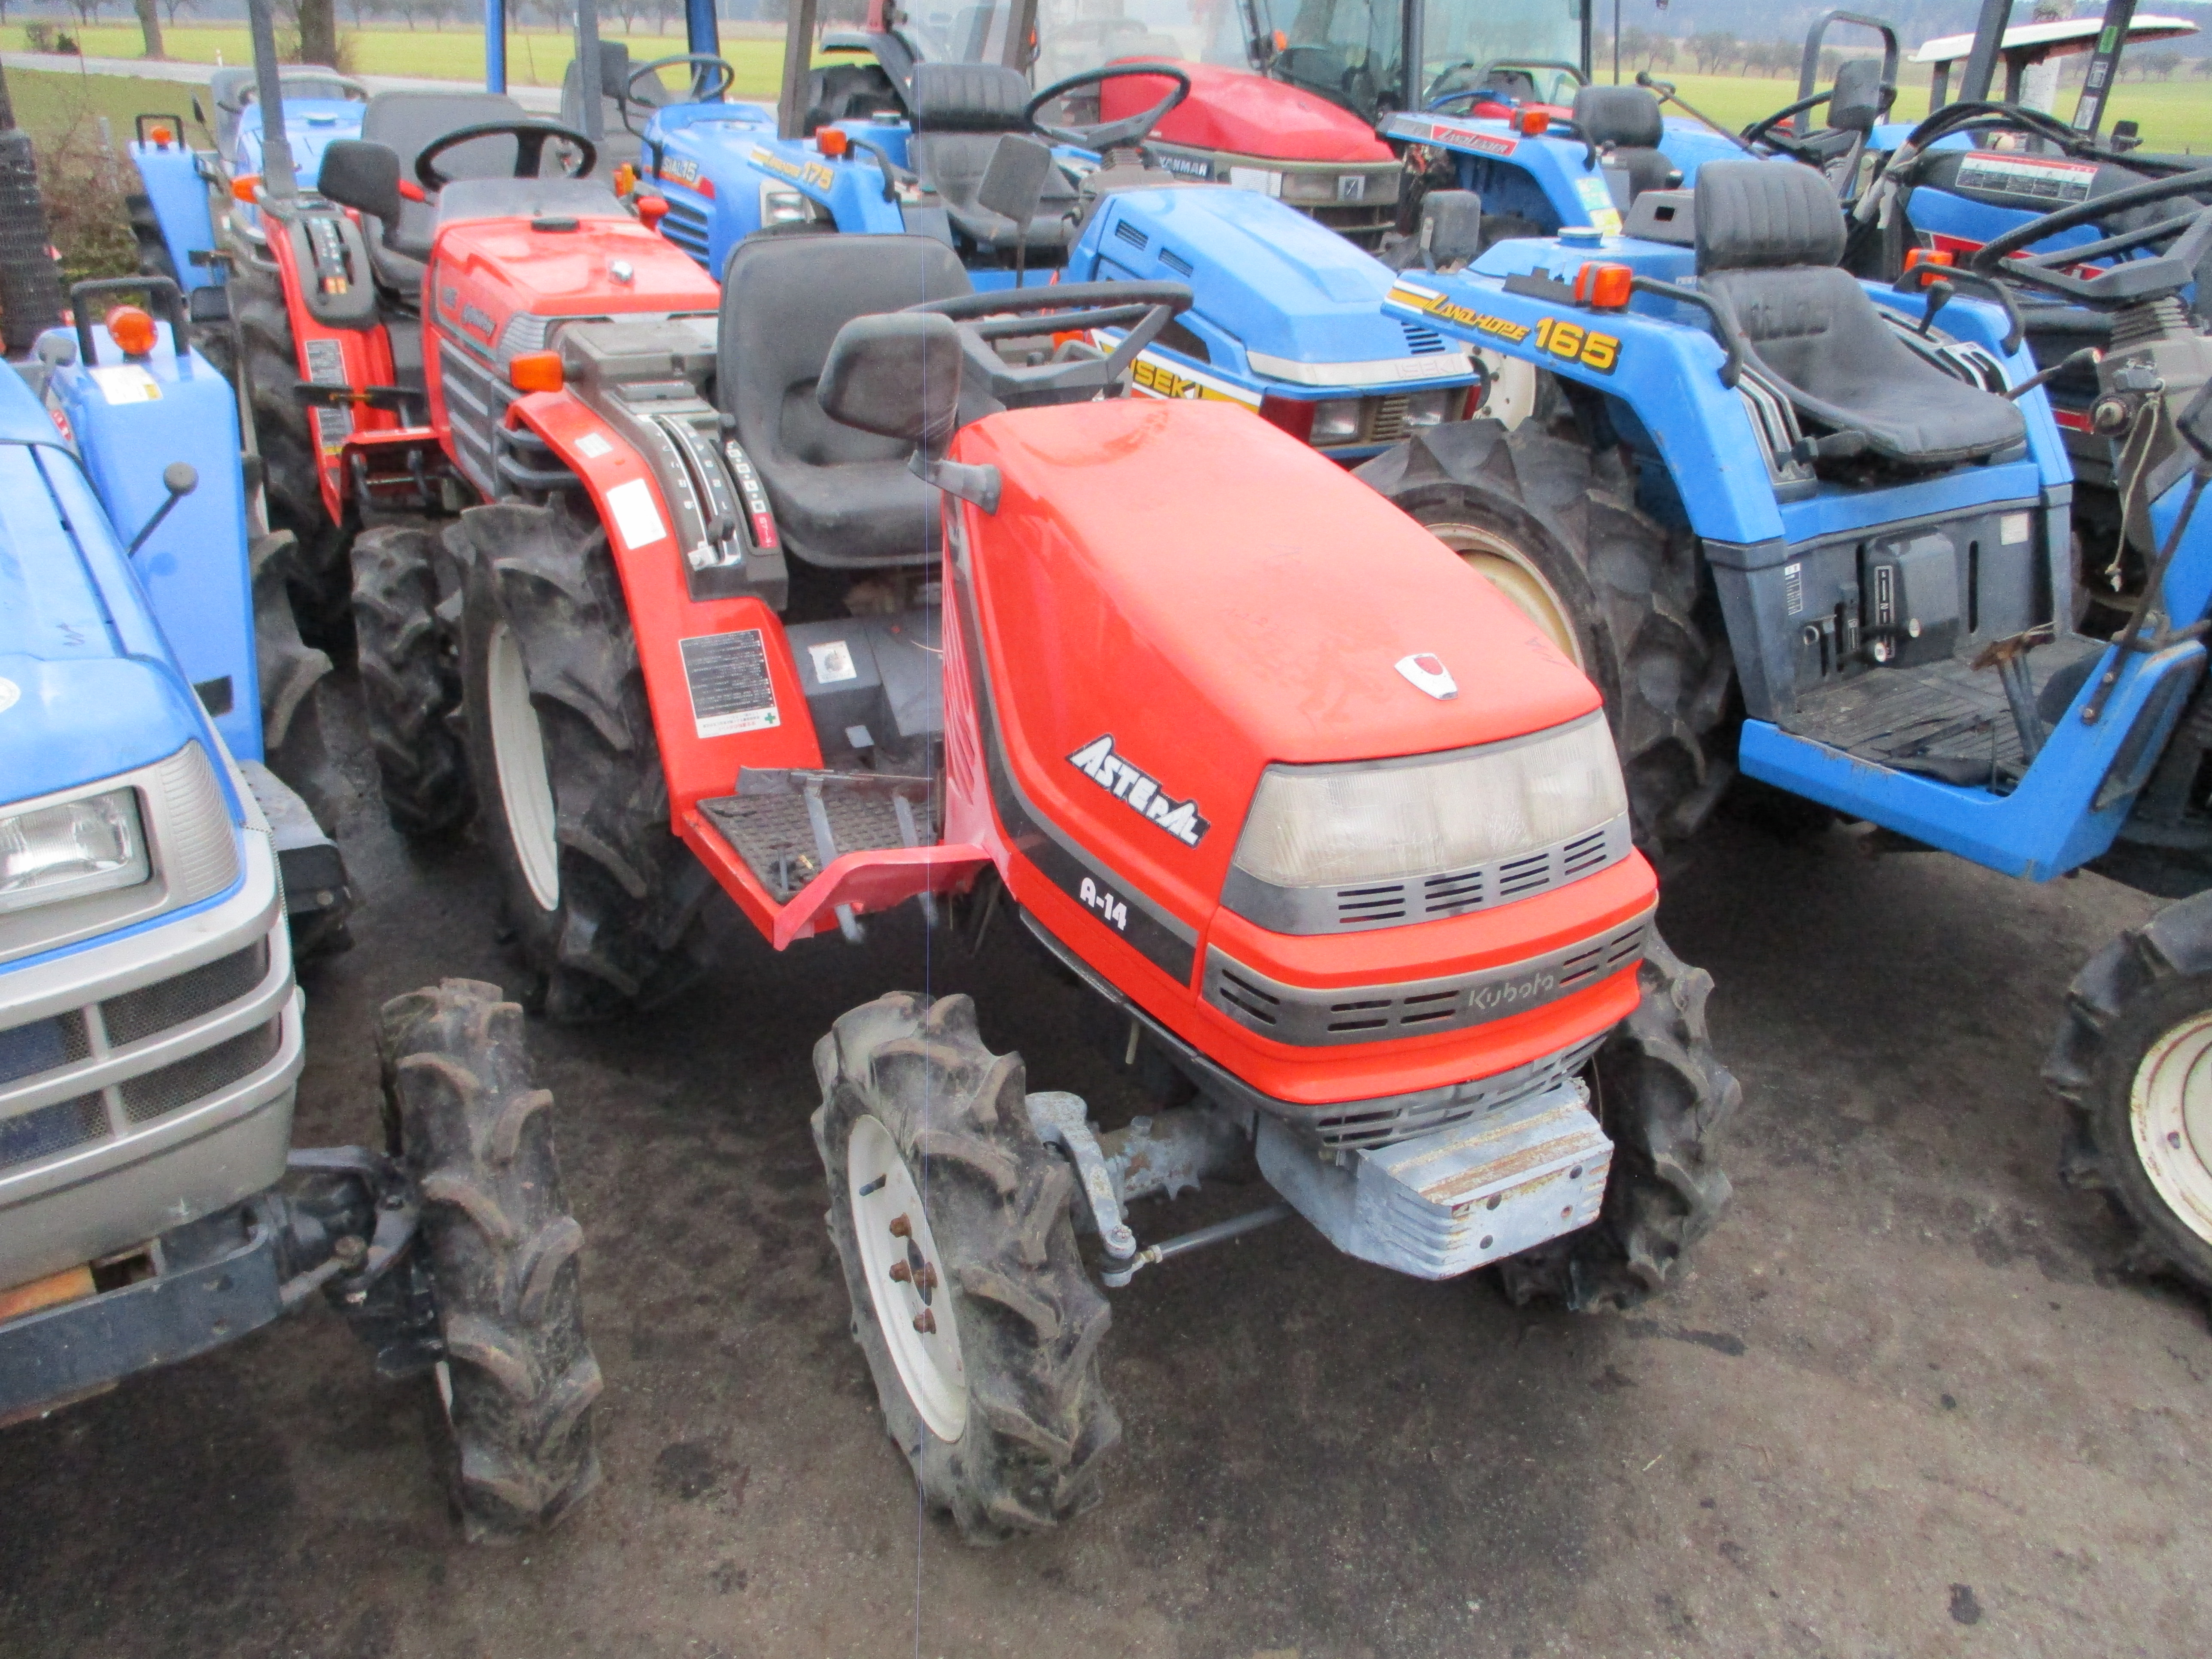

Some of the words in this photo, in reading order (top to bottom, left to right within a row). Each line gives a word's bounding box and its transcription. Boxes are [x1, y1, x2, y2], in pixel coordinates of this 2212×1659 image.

[803, 161, 834, 191] 175
[1534, 317, 1621, 371] 165
[1130, 357, 1202, 399] ISEKI
[1080, 877, 1127, 931] A-14
[1468, 972, 1554, 1010] Kubota
